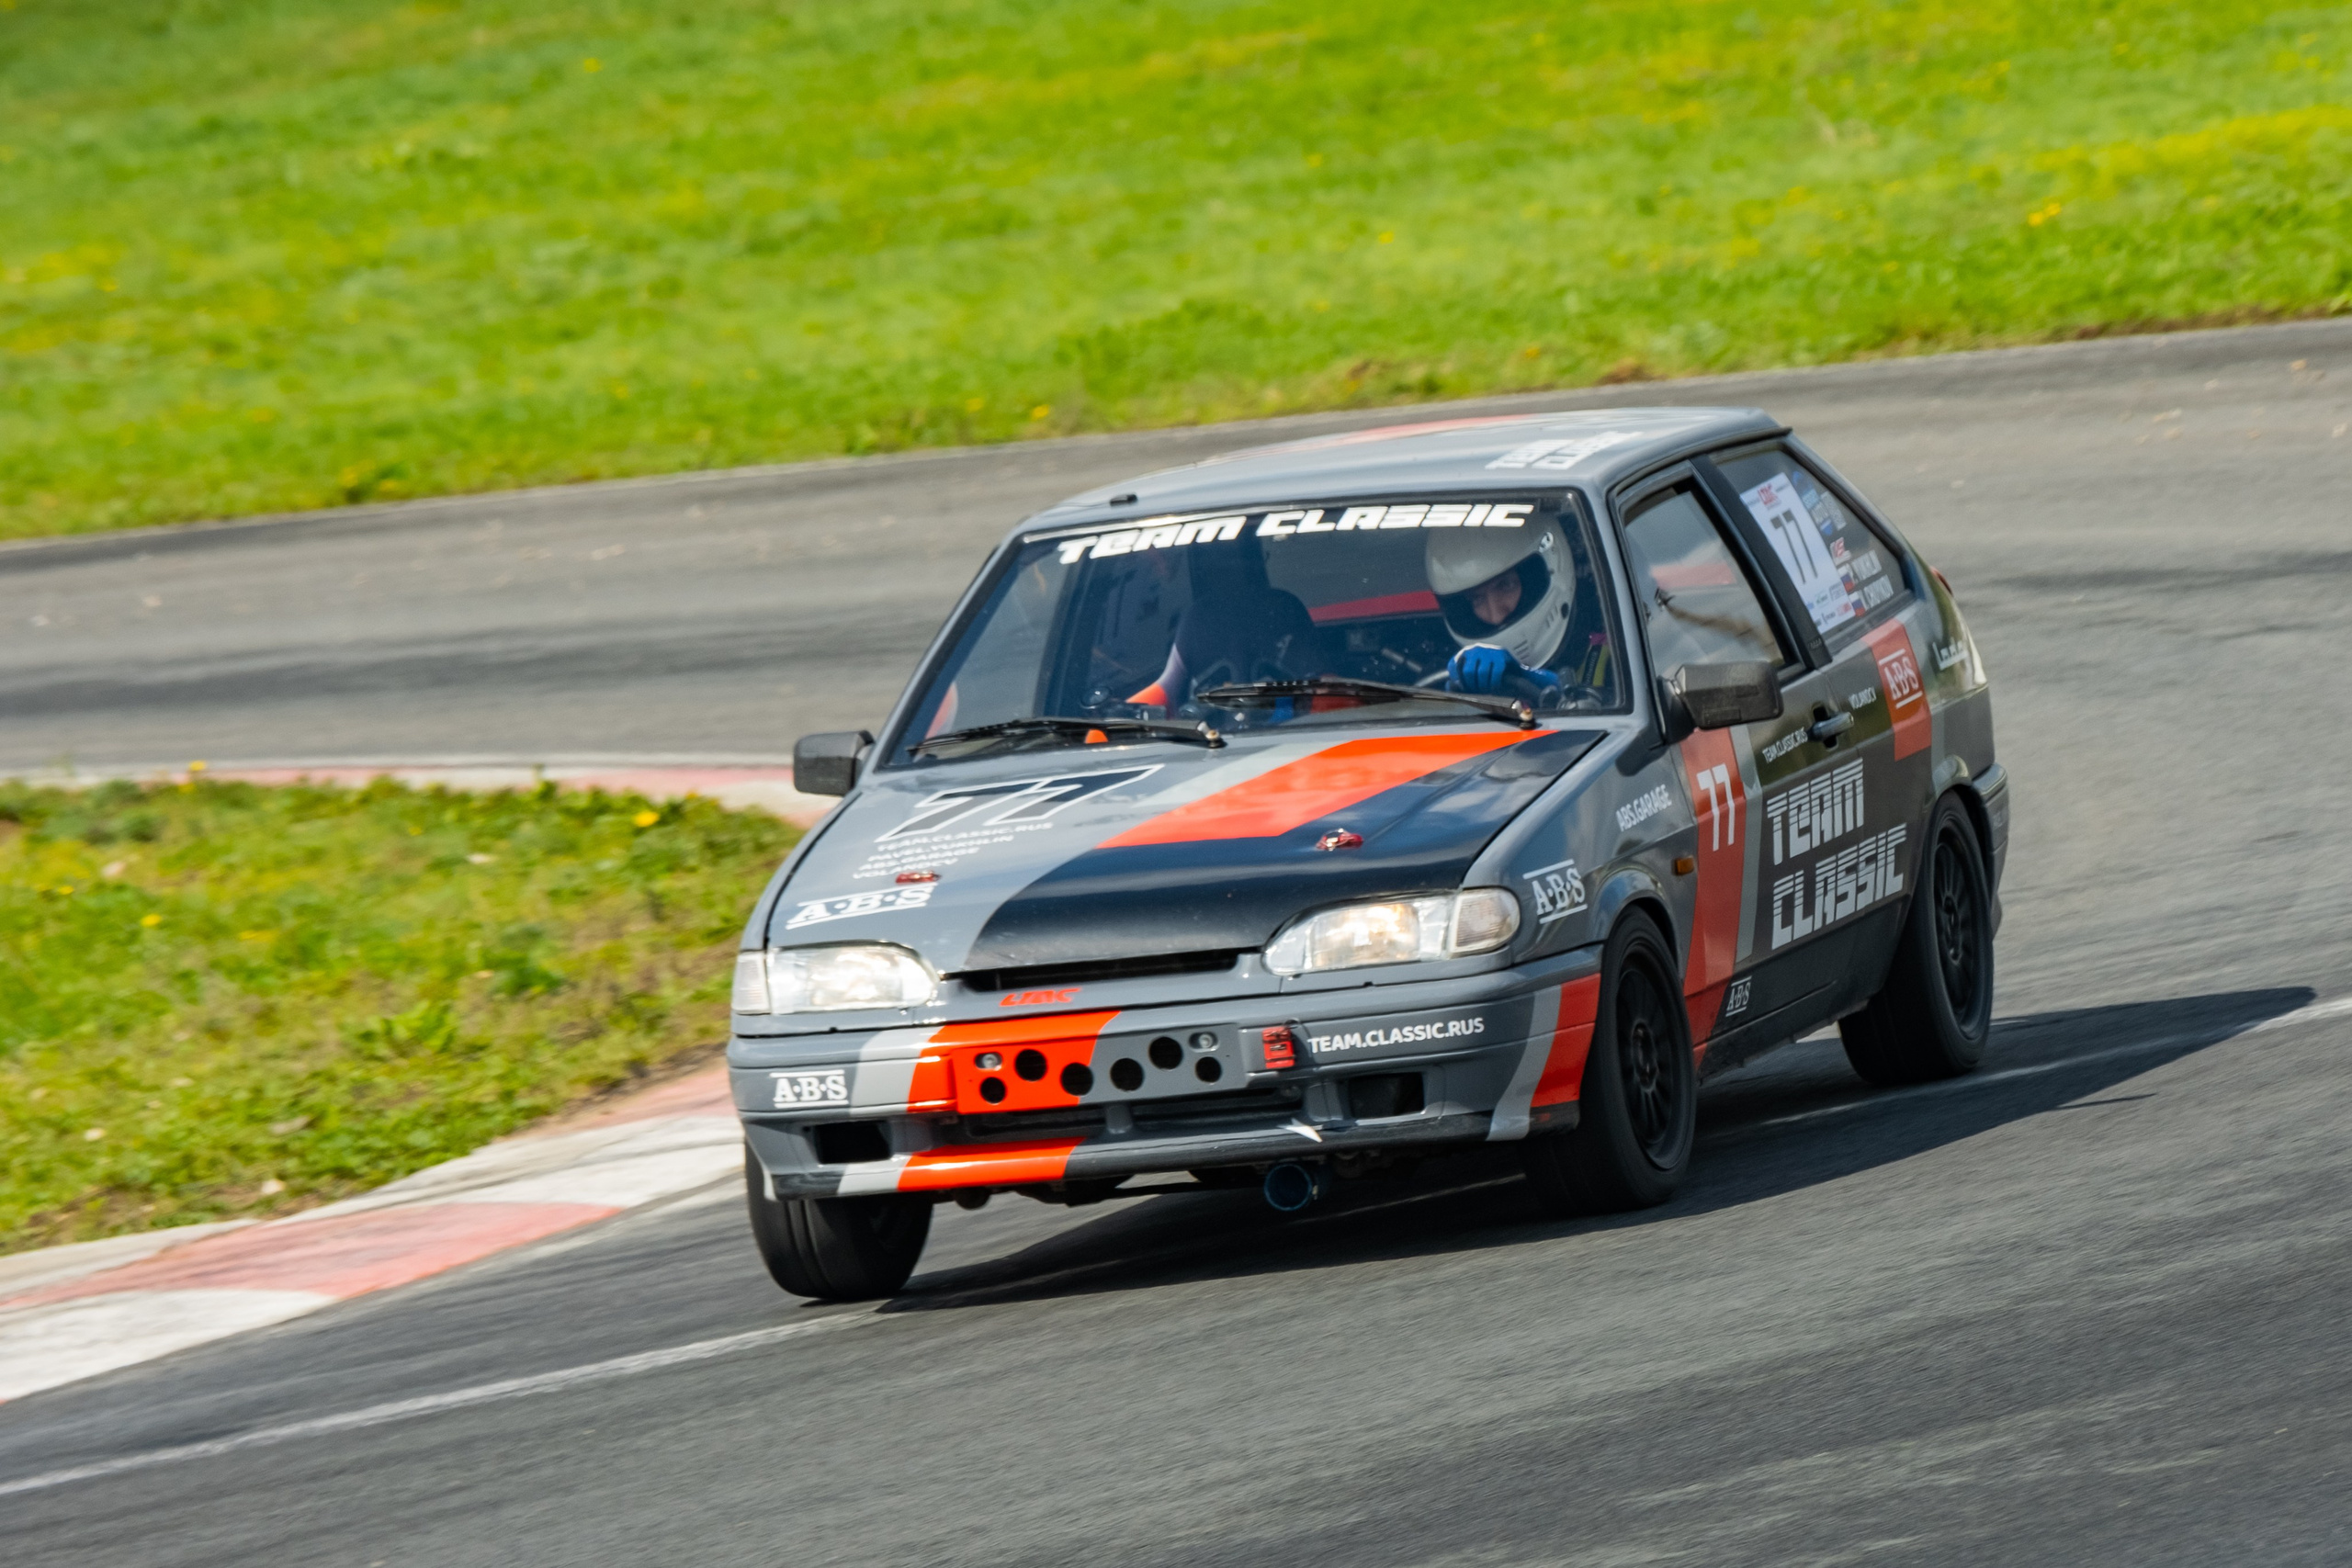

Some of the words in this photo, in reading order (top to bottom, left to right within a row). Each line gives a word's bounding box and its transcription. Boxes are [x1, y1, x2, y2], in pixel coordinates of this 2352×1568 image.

[1057, 516, 1246, 564] TEAM
[1256, 504, 1534, 536] CLASSIC
[1770, 508, 1818, 584] 77
[874, 763, 1166, 843] 77
[1615, 784, 1672, 832] ABS.GARAGE
[1696, 763, 1735, 852] 77
[1767, 757, 1864, 865] TEAM
[1771, 822, 1907, 951] CLASSIC
[1307, 1017, 1484, 1054] TEAM.CLASSIC.RUS
